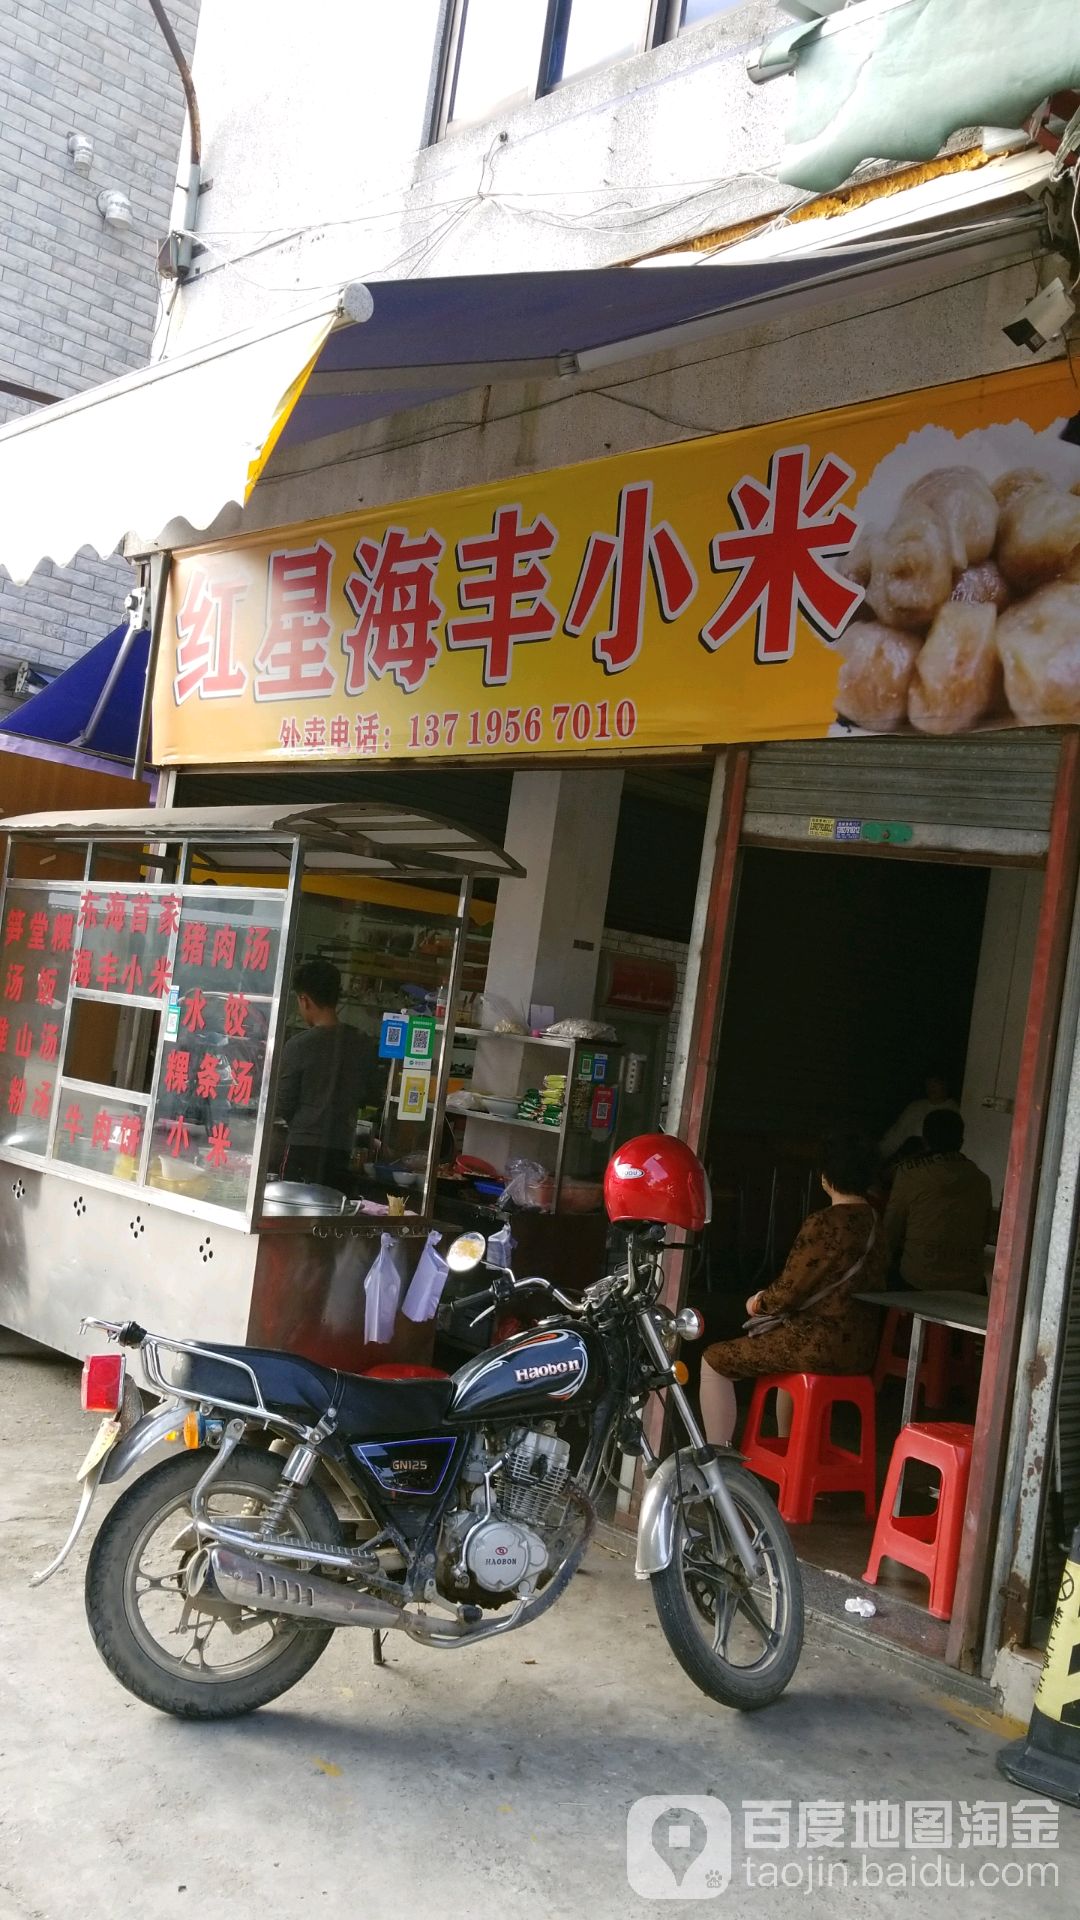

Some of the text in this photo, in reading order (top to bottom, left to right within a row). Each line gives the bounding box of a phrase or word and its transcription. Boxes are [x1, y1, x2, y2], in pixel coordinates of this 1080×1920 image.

[175, 446, 867, 702] 红星海丰小米
[408, 713, 459, 748] 137
[468, 706, 542, 746] 1956
[552, 700, 636, 742] 7010
[180, 922, 270, 971] 猪肉汤
[71, 950, 172, 998] 海丰小米
[182, 988, 250, 1037] 水饺
[165, 1049, 254, 1105] 粿条汤
[167, 1115, 232, 1168] 小米
[514, 1359, 580, 1382] Haobon
[392, 1460, 427, 1471] GN125
[485, 1558, 517, 1566] HAOBON
